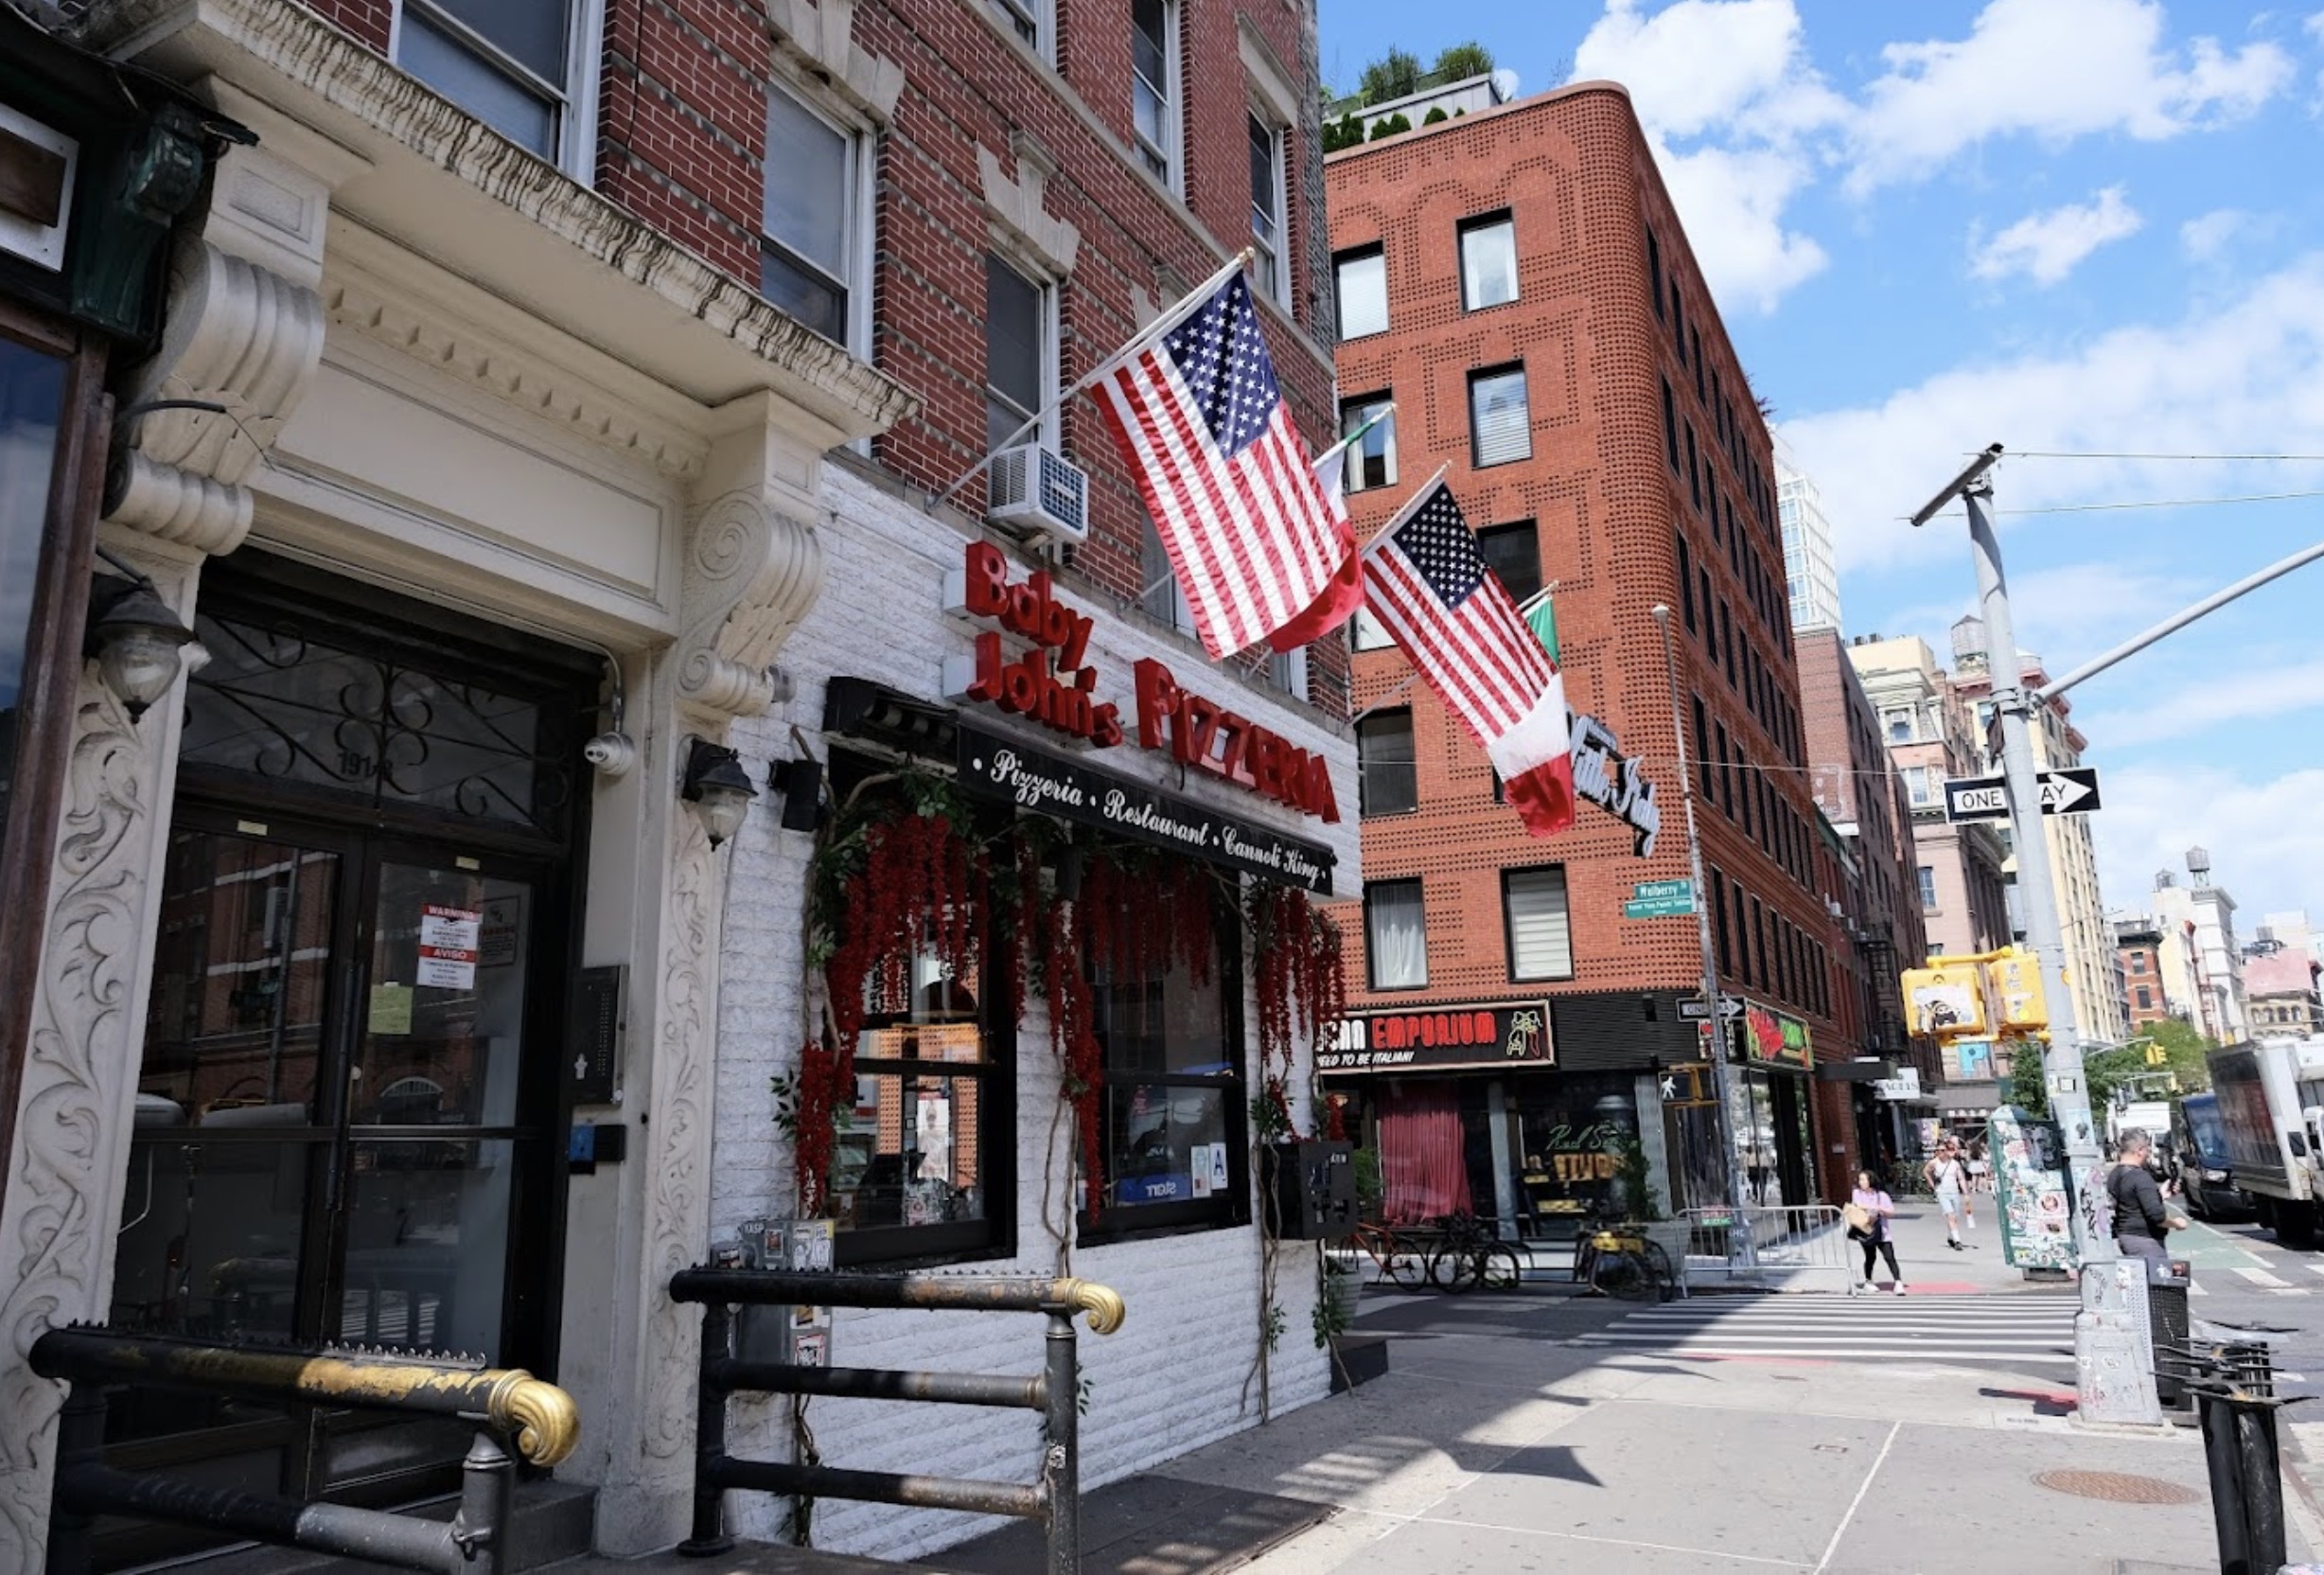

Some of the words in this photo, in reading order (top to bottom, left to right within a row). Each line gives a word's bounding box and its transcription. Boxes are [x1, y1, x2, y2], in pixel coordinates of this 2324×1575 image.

[966, 540, 1094, 672] Baby
[966, 631, 1123, 748] John's
[1962, 790, 2002, 808] ONE
[2041, 785, 2067, 802] AY
[990, 750, 1083, 806] Pizzeria
[1103, 788, 1209, 847] Restaurant
[1222, 825, 1281, 869] Cannoli
[1283, 848, 1320, 890] King
[1640, 885, 1678, 898] Mulberry
[428, 906, 475, 920] WARNING
[433, 948, 467, 960] AVISO
[1372, 1012, 1497, 1049] EMPORIUM
[1341, 1053, 1355, 1066] TO
[1356, 1053, 1371, 1065] BE
